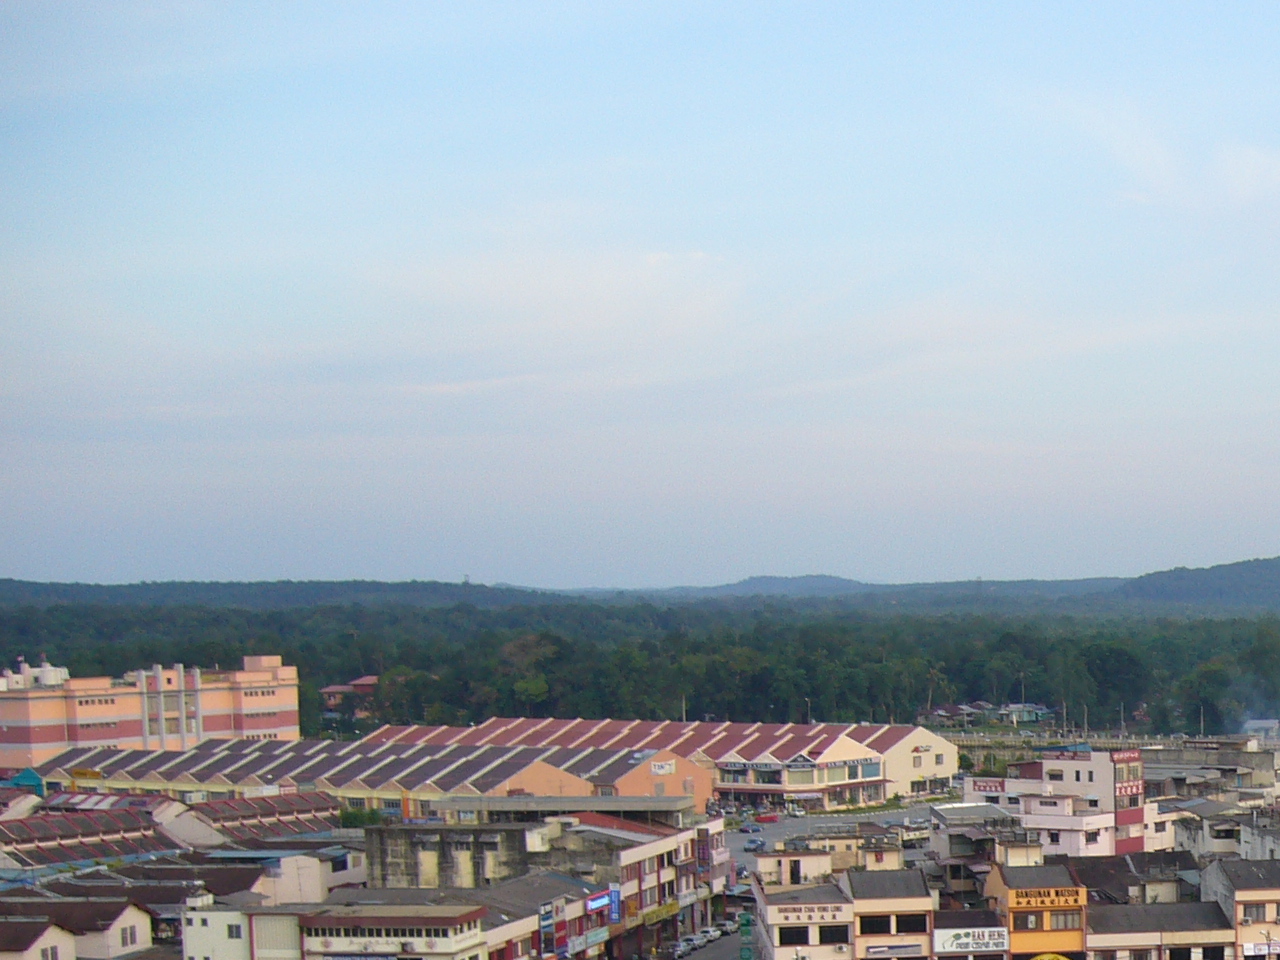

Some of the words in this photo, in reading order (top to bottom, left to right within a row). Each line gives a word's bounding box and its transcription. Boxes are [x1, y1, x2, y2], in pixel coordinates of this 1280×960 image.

[1015, 890, 1051, 899] BANGUNAN
[1054, 889, 1079, 898] WATSON
[972, 931, 986, 941] HAN
